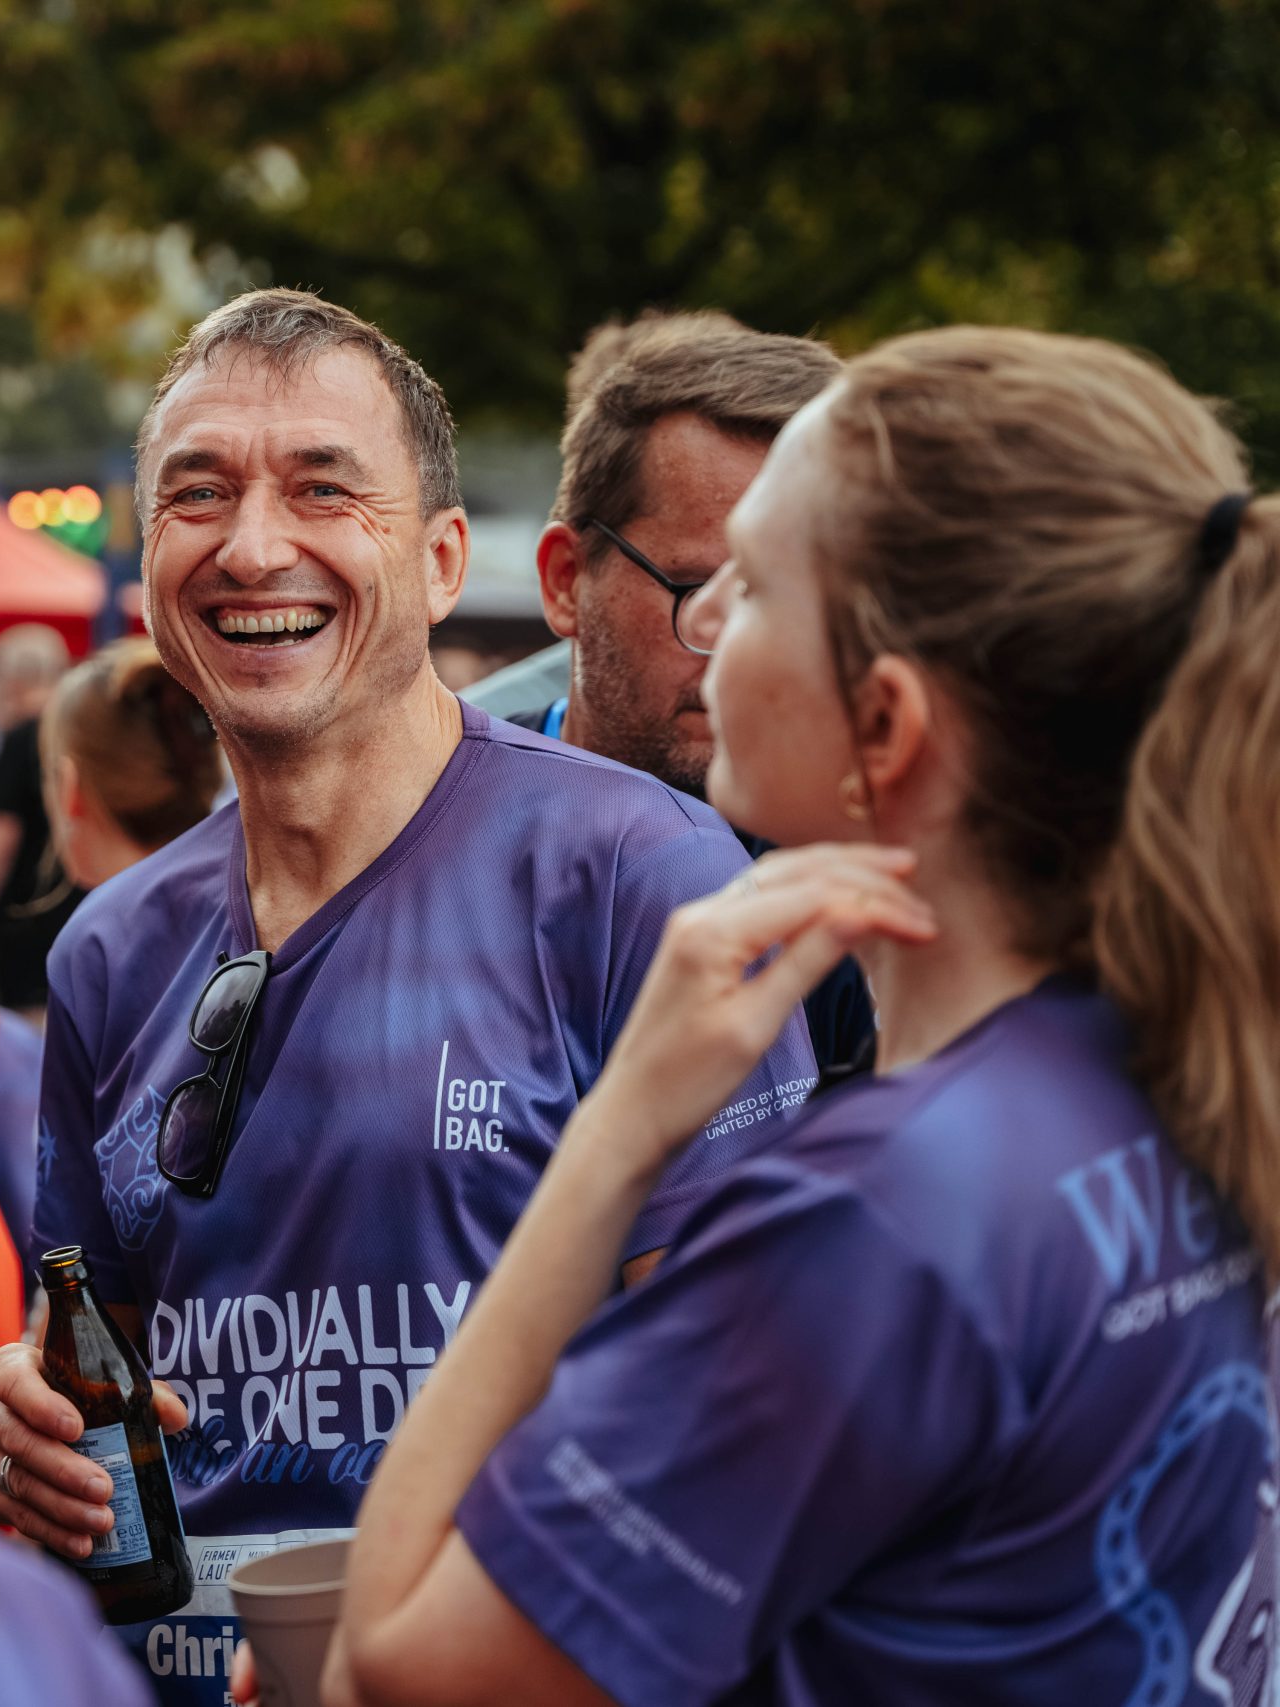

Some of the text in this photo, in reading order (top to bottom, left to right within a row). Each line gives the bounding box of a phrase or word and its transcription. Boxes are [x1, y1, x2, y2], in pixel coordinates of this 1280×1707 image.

[447, 1078, 507, 1114] GOT
[758, 1088, 774, 1105] BY
[705, 1091, 808, 1140] UNITED BY CARE
[445, 1116, 510, 1153] BAG.
[240, 1369, 346, 1451] ONE
[198, 1563, 233, 1581] LAUF
[203, 1550, 237, 1562] FIRMEN
